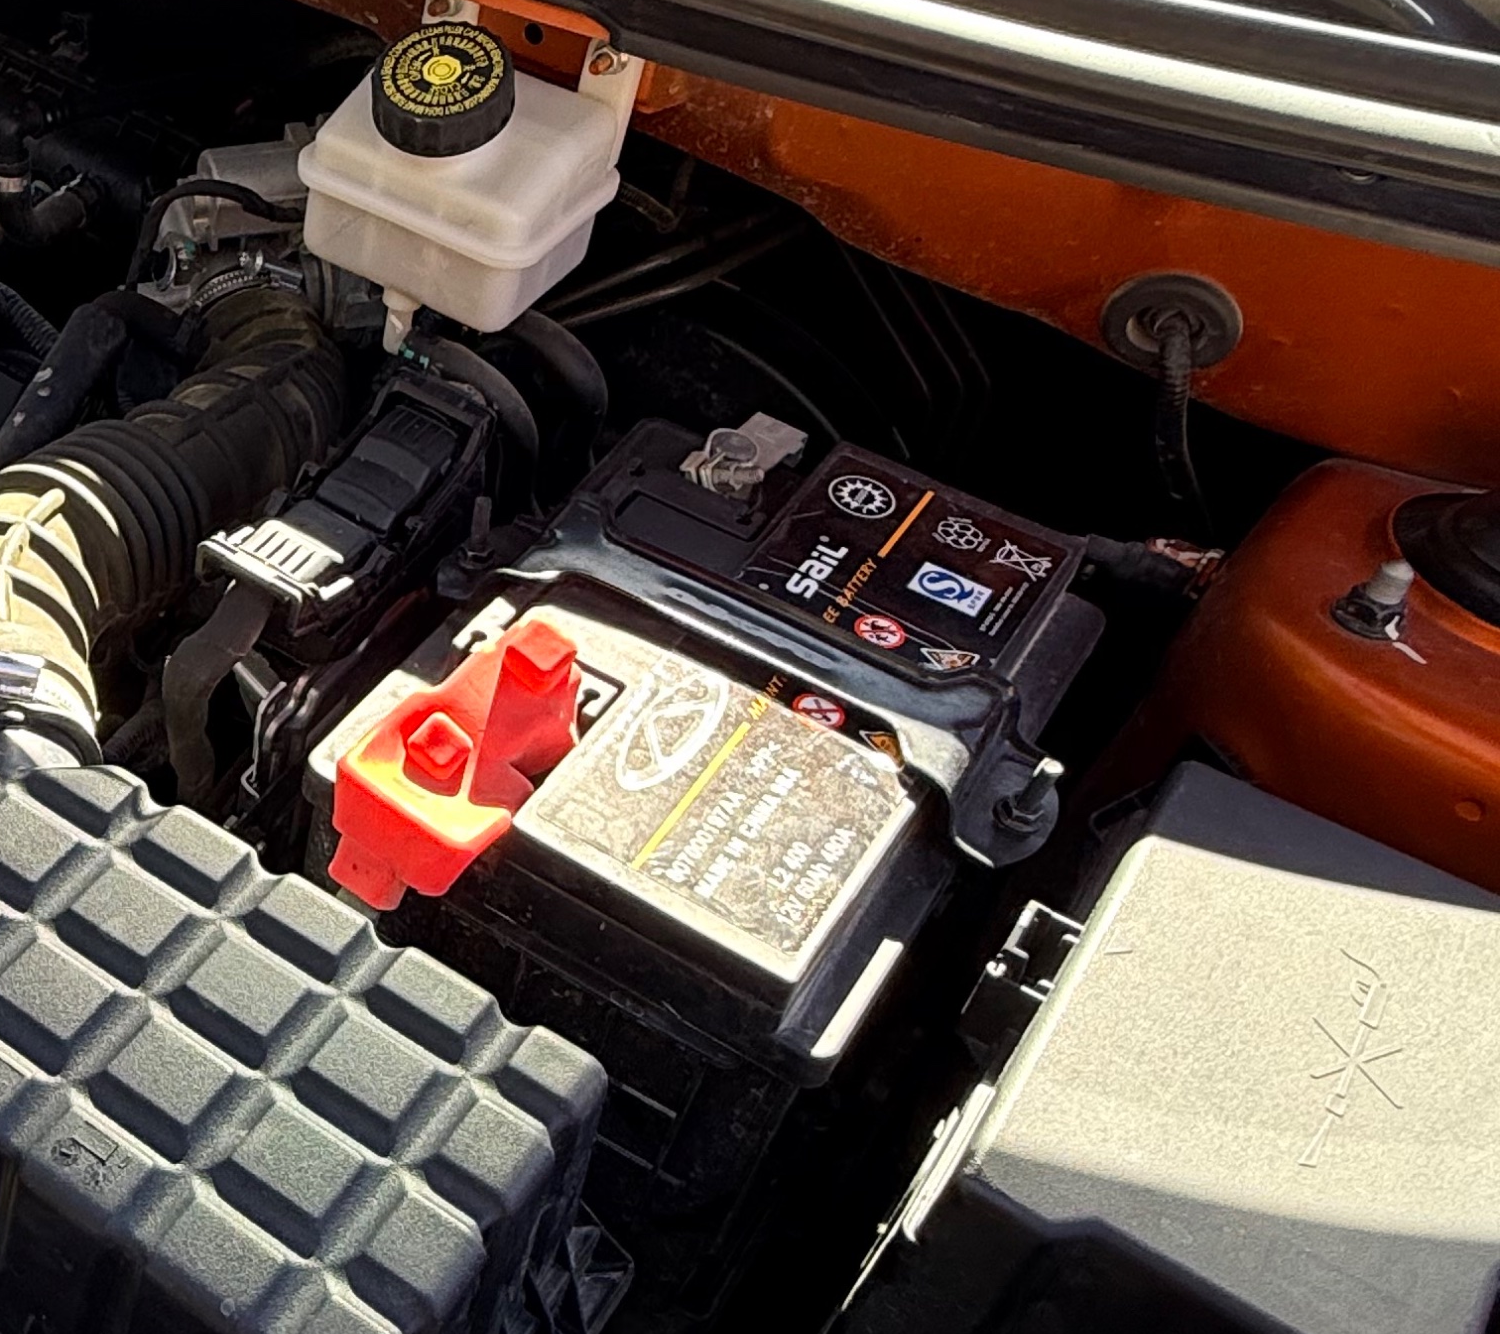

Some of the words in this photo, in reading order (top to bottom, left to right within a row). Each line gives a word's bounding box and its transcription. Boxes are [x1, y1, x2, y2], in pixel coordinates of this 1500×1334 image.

[835, 557, 878, 609] BATTERY
[692, 852, 736, 899] MADE
[723, 834, 749, 864] IN
